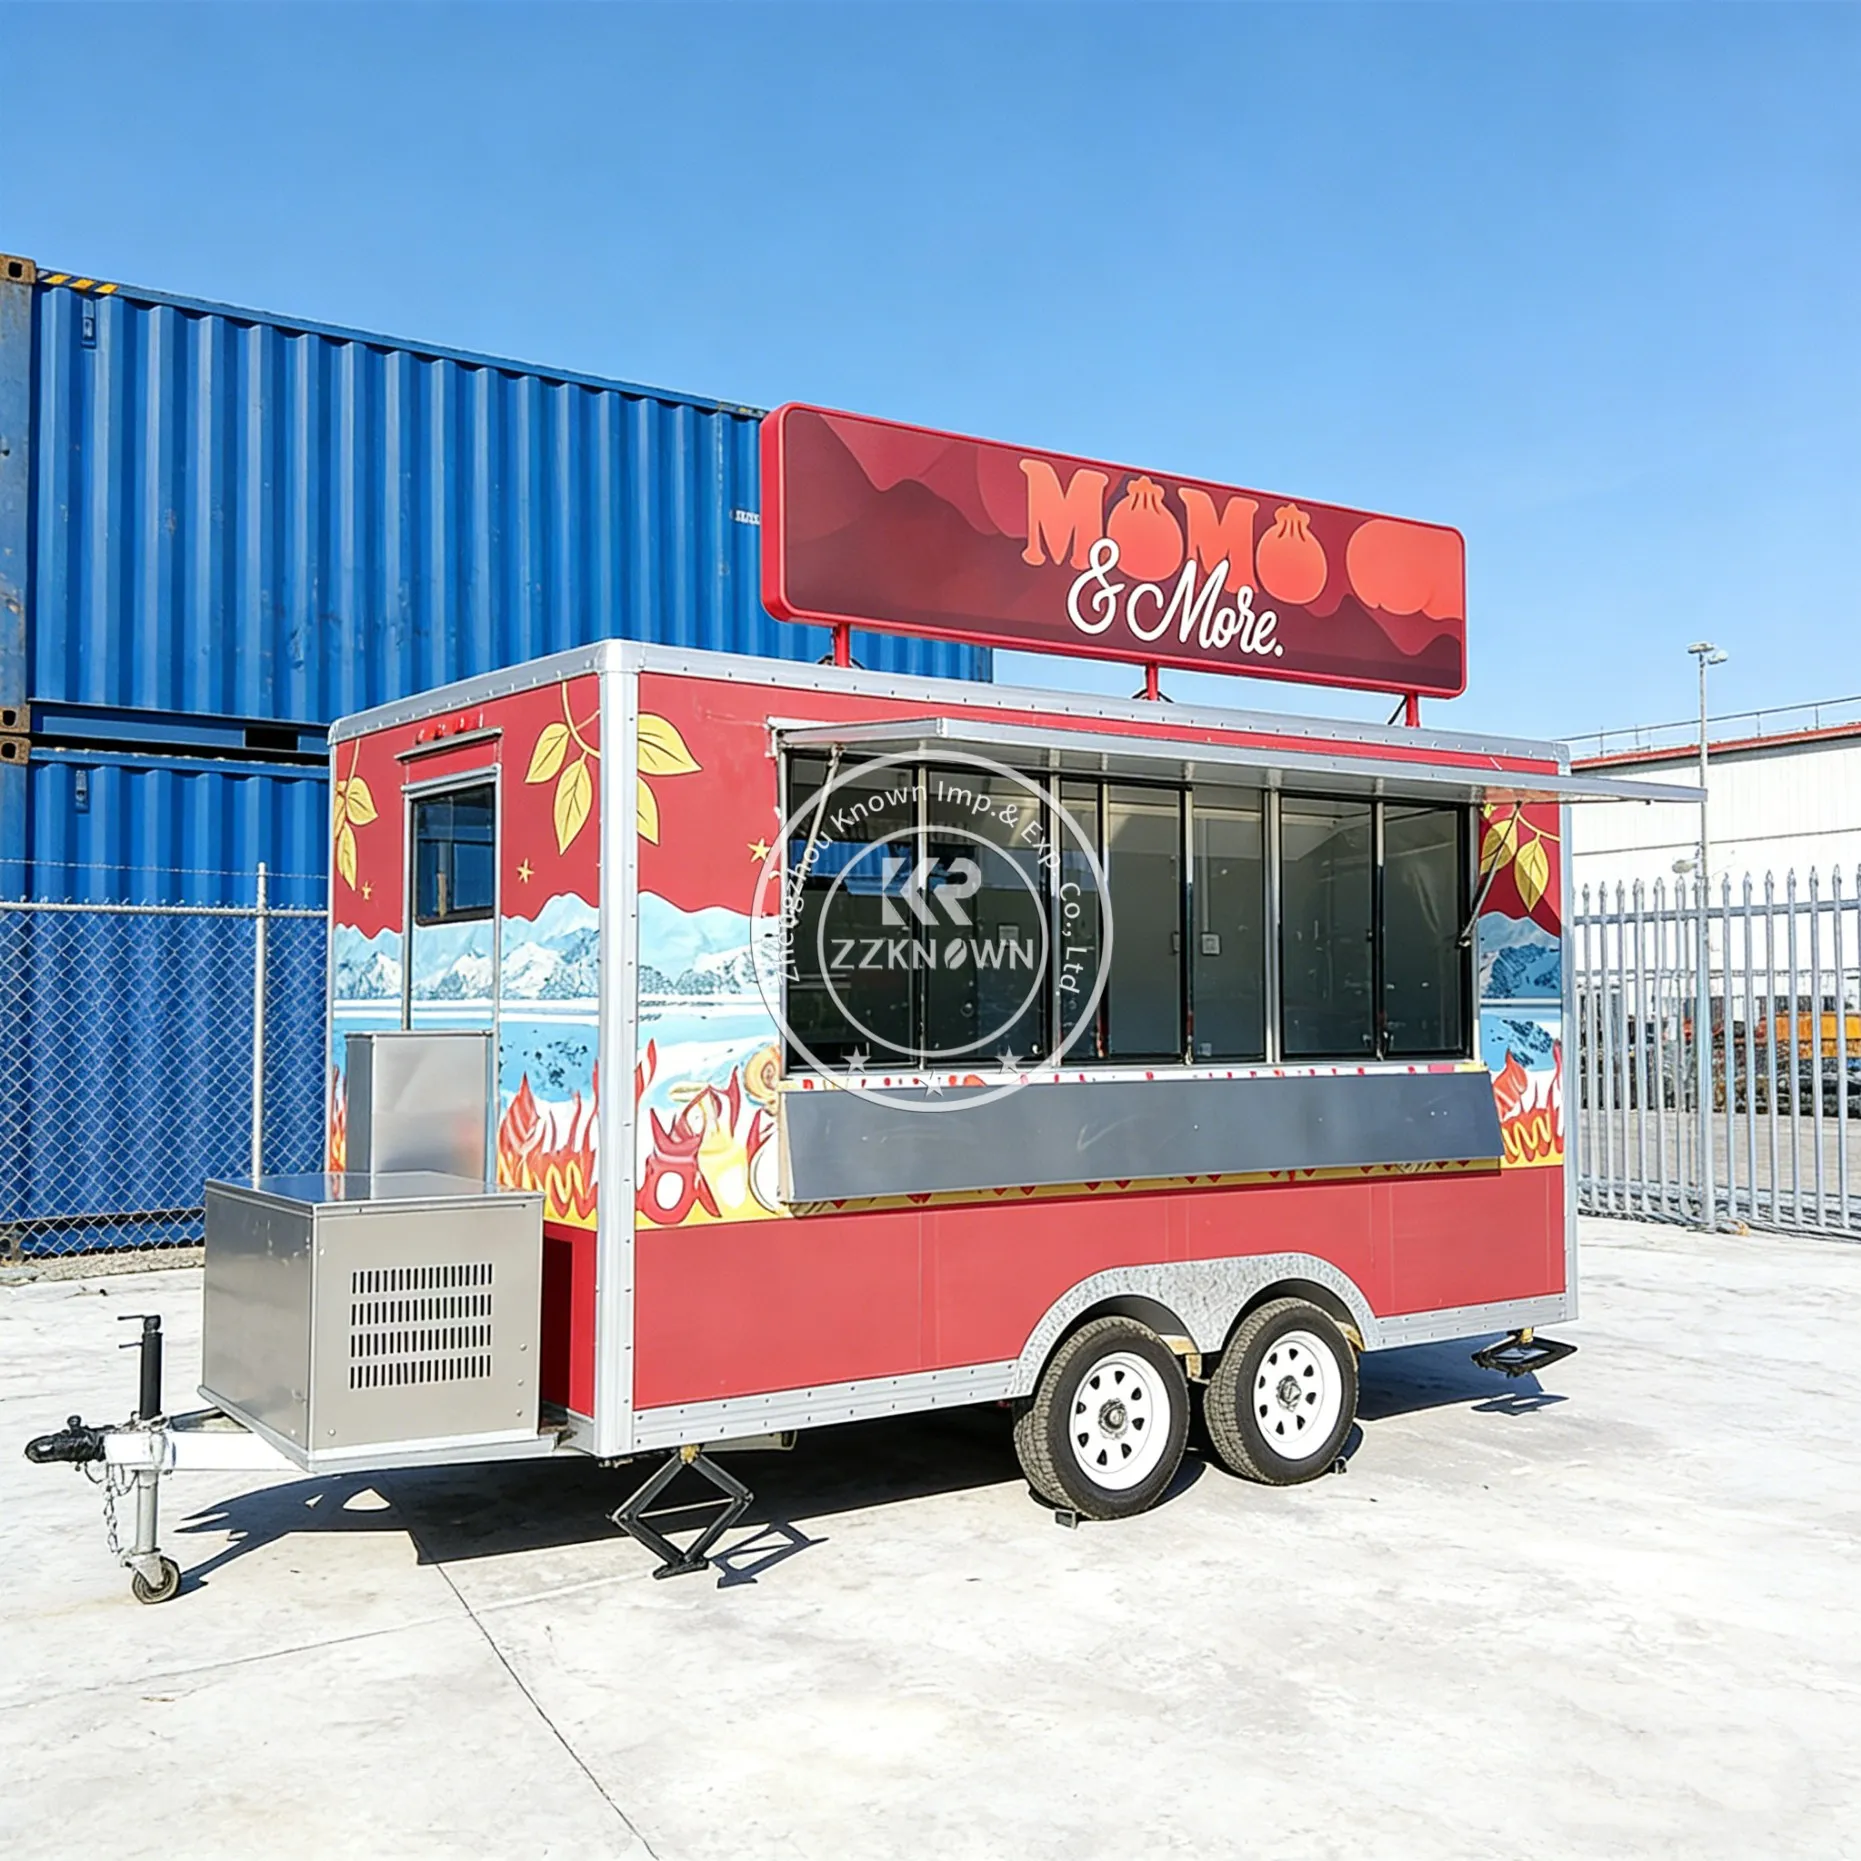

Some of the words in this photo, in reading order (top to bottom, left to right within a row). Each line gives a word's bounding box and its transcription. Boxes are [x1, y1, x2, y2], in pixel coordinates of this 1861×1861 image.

[1019, 458, 1328, 604] MOMO
[1067, 537, 1125, 635] &
[1126, 558, 1284, 658] More.
